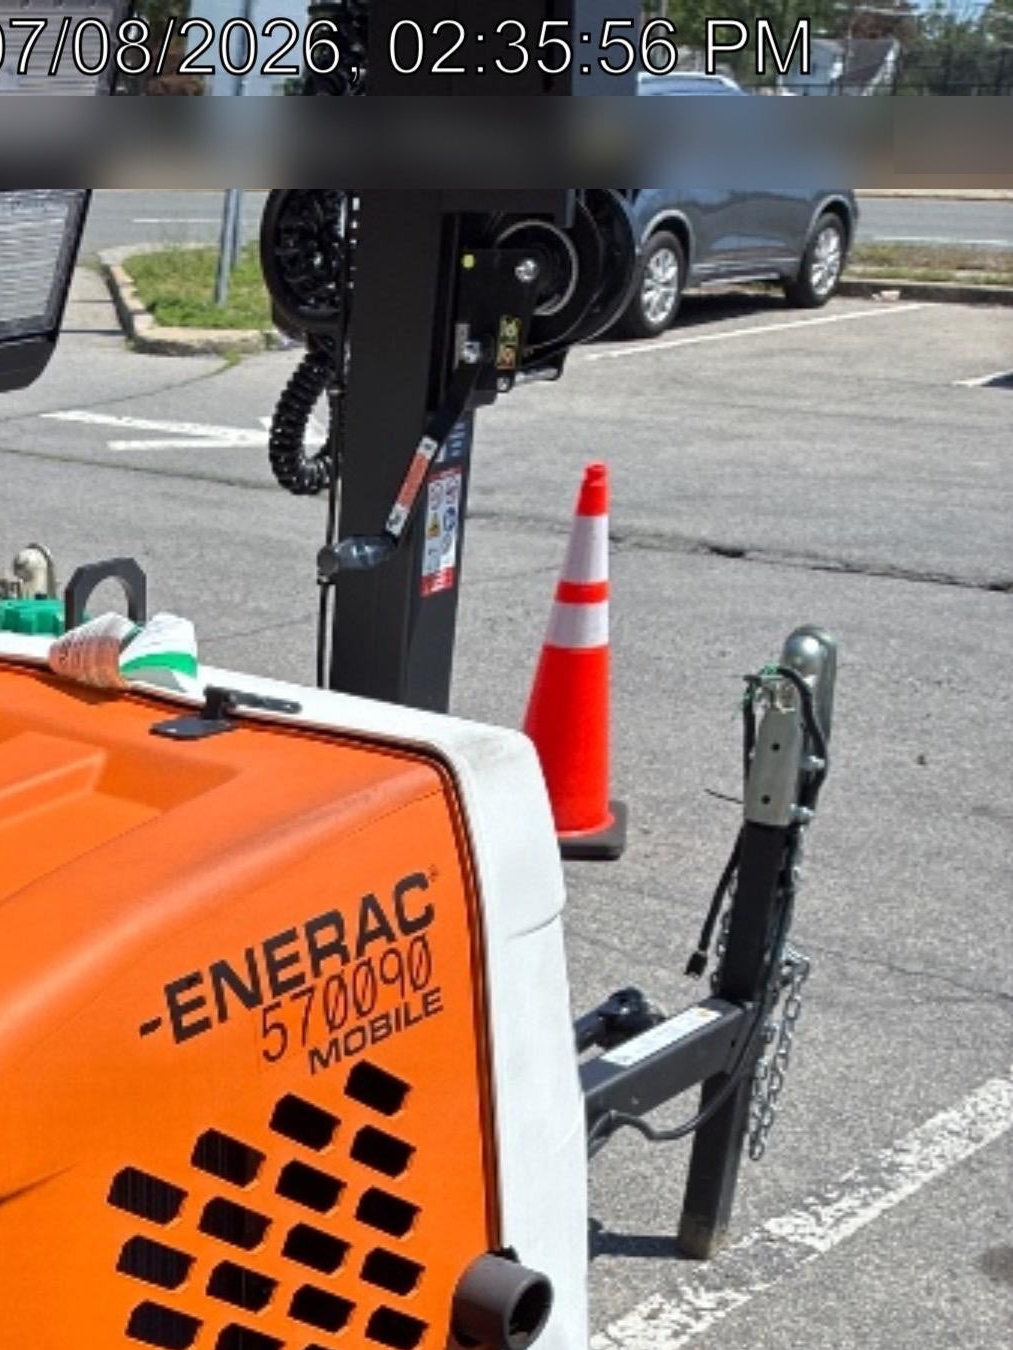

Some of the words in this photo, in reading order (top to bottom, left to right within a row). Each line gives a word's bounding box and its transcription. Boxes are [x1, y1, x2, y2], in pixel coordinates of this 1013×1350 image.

[139, 871, 436, 1045] ENERAC
[261, 935, 432, 1063] 570090
[309, 988, 443, 1075] MOBILE
